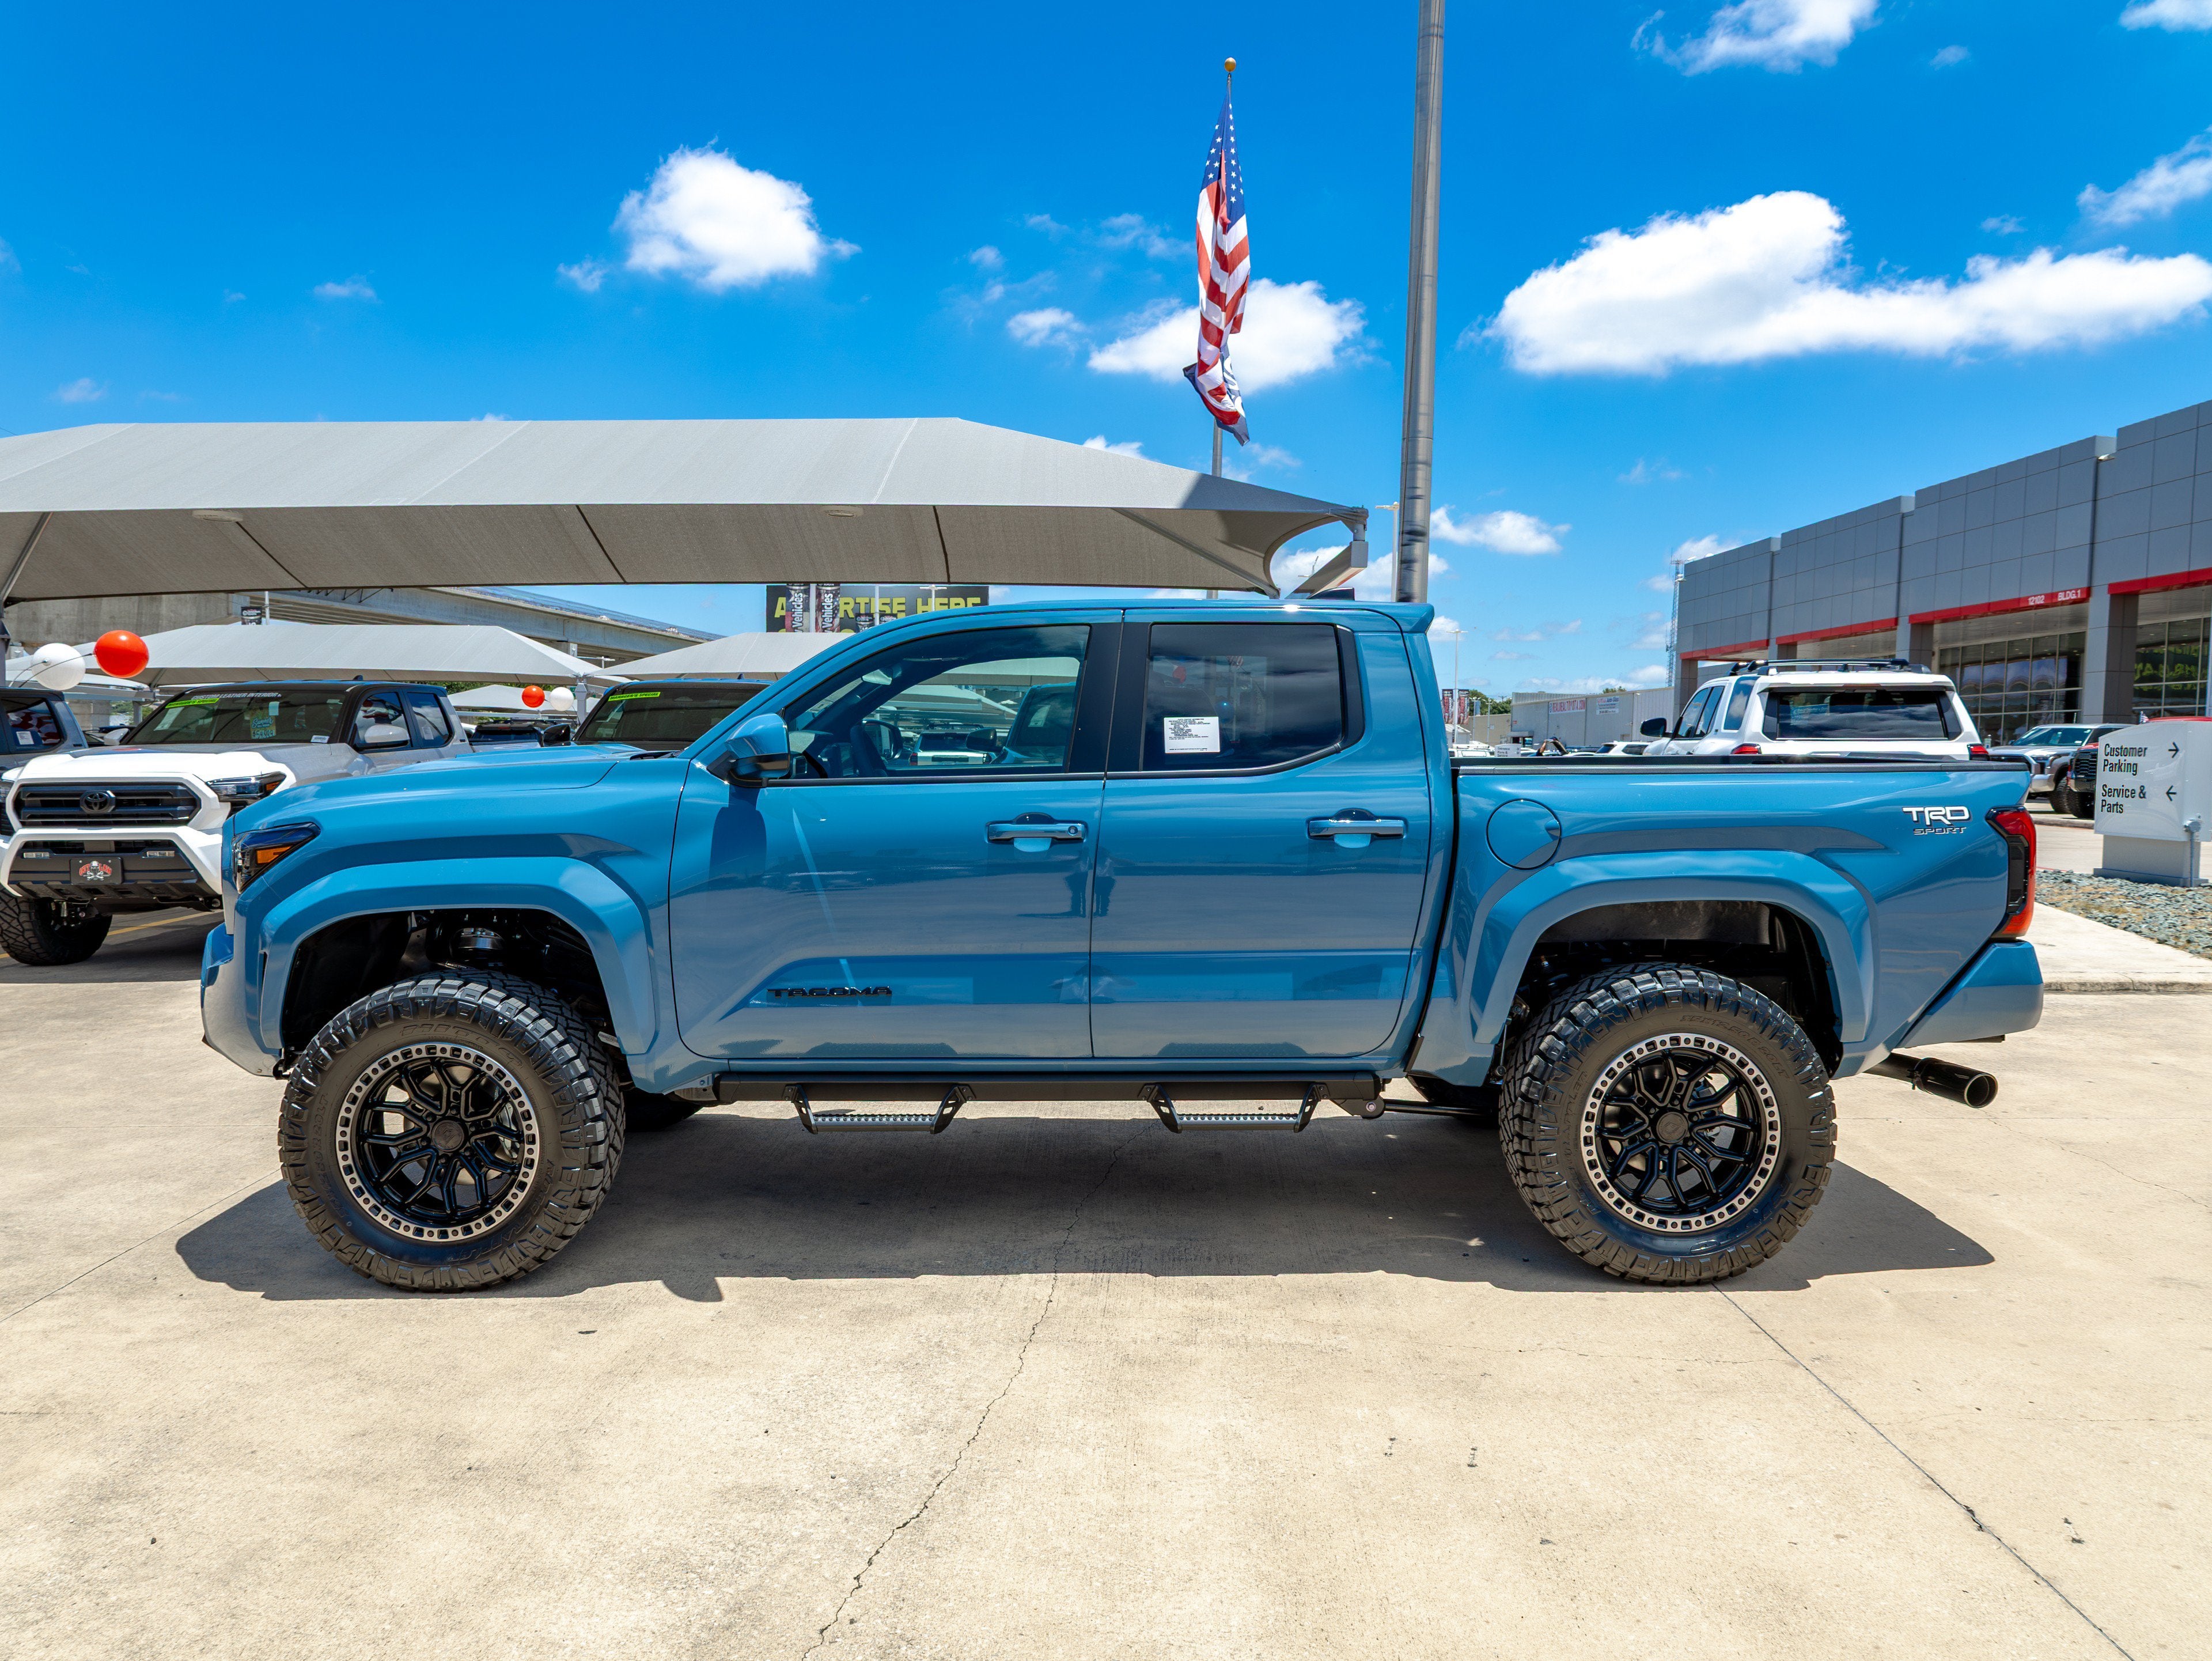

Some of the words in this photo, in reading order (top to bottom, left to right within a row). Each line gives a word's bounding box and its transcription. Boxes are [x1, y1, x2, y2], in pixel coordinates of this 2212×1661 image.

[774, 597, 906, 618] ARTISE
[791, 592, 803, 628] Vehicles
[821, 593, 834, 629] Vehicles
[2104, 743, 2148, 757] Customer
[2103, 759, 2138, 776] Parking
[2101, 784, 2136, 799] Service
[2138, 785, 2147, 799] &
[2100, 799, 2124, 814] Parts
[1902, 806, 1971, 826] TRD
[1912, 826, 1967, 835] SPORT
[767, 985, 893, 998] TACOMA
